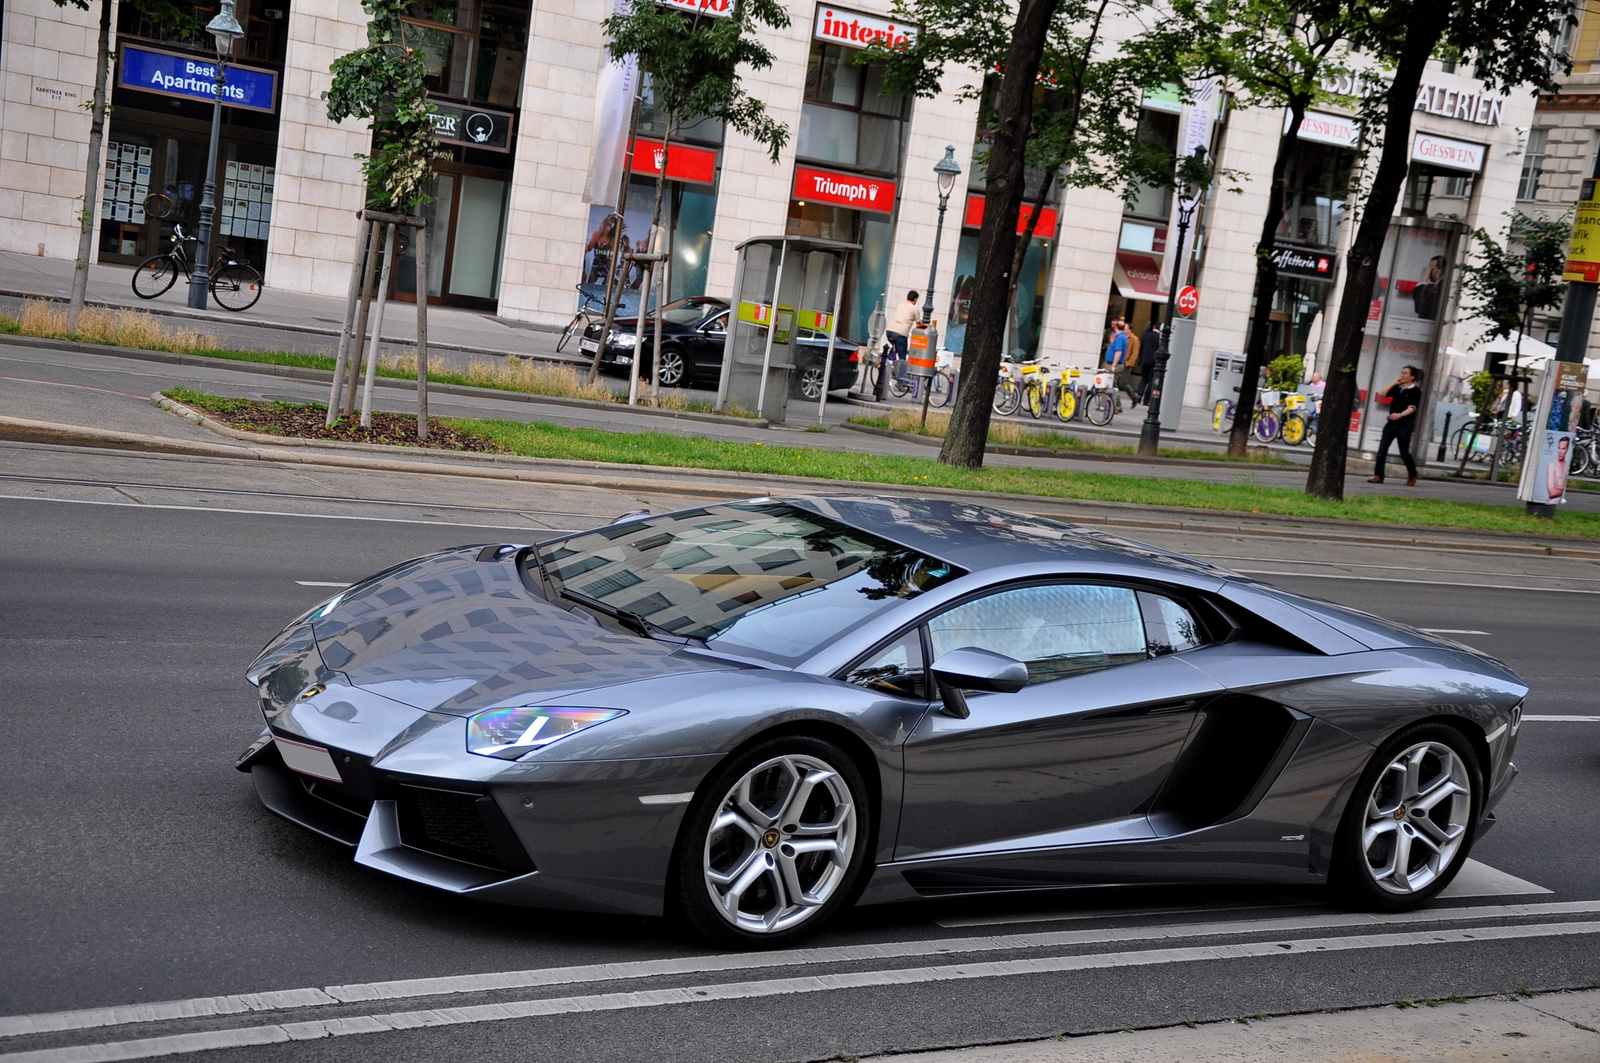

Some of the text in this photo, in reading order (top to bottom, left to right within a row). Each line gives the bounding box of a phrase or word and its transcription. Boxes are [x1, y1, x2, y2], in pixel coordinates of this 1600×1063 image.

[822, 10, 910, 51] interio
[186, 61, 215, 77] Best
[151, 69, 244, 99] Apartments
[1413, 82, 1505, 128] ALERIEN
[426, 113, 456, 131] TER
[1300, 118, 1352, 140] IESSWEIN
[813, 176, 867, 202] Triumph
